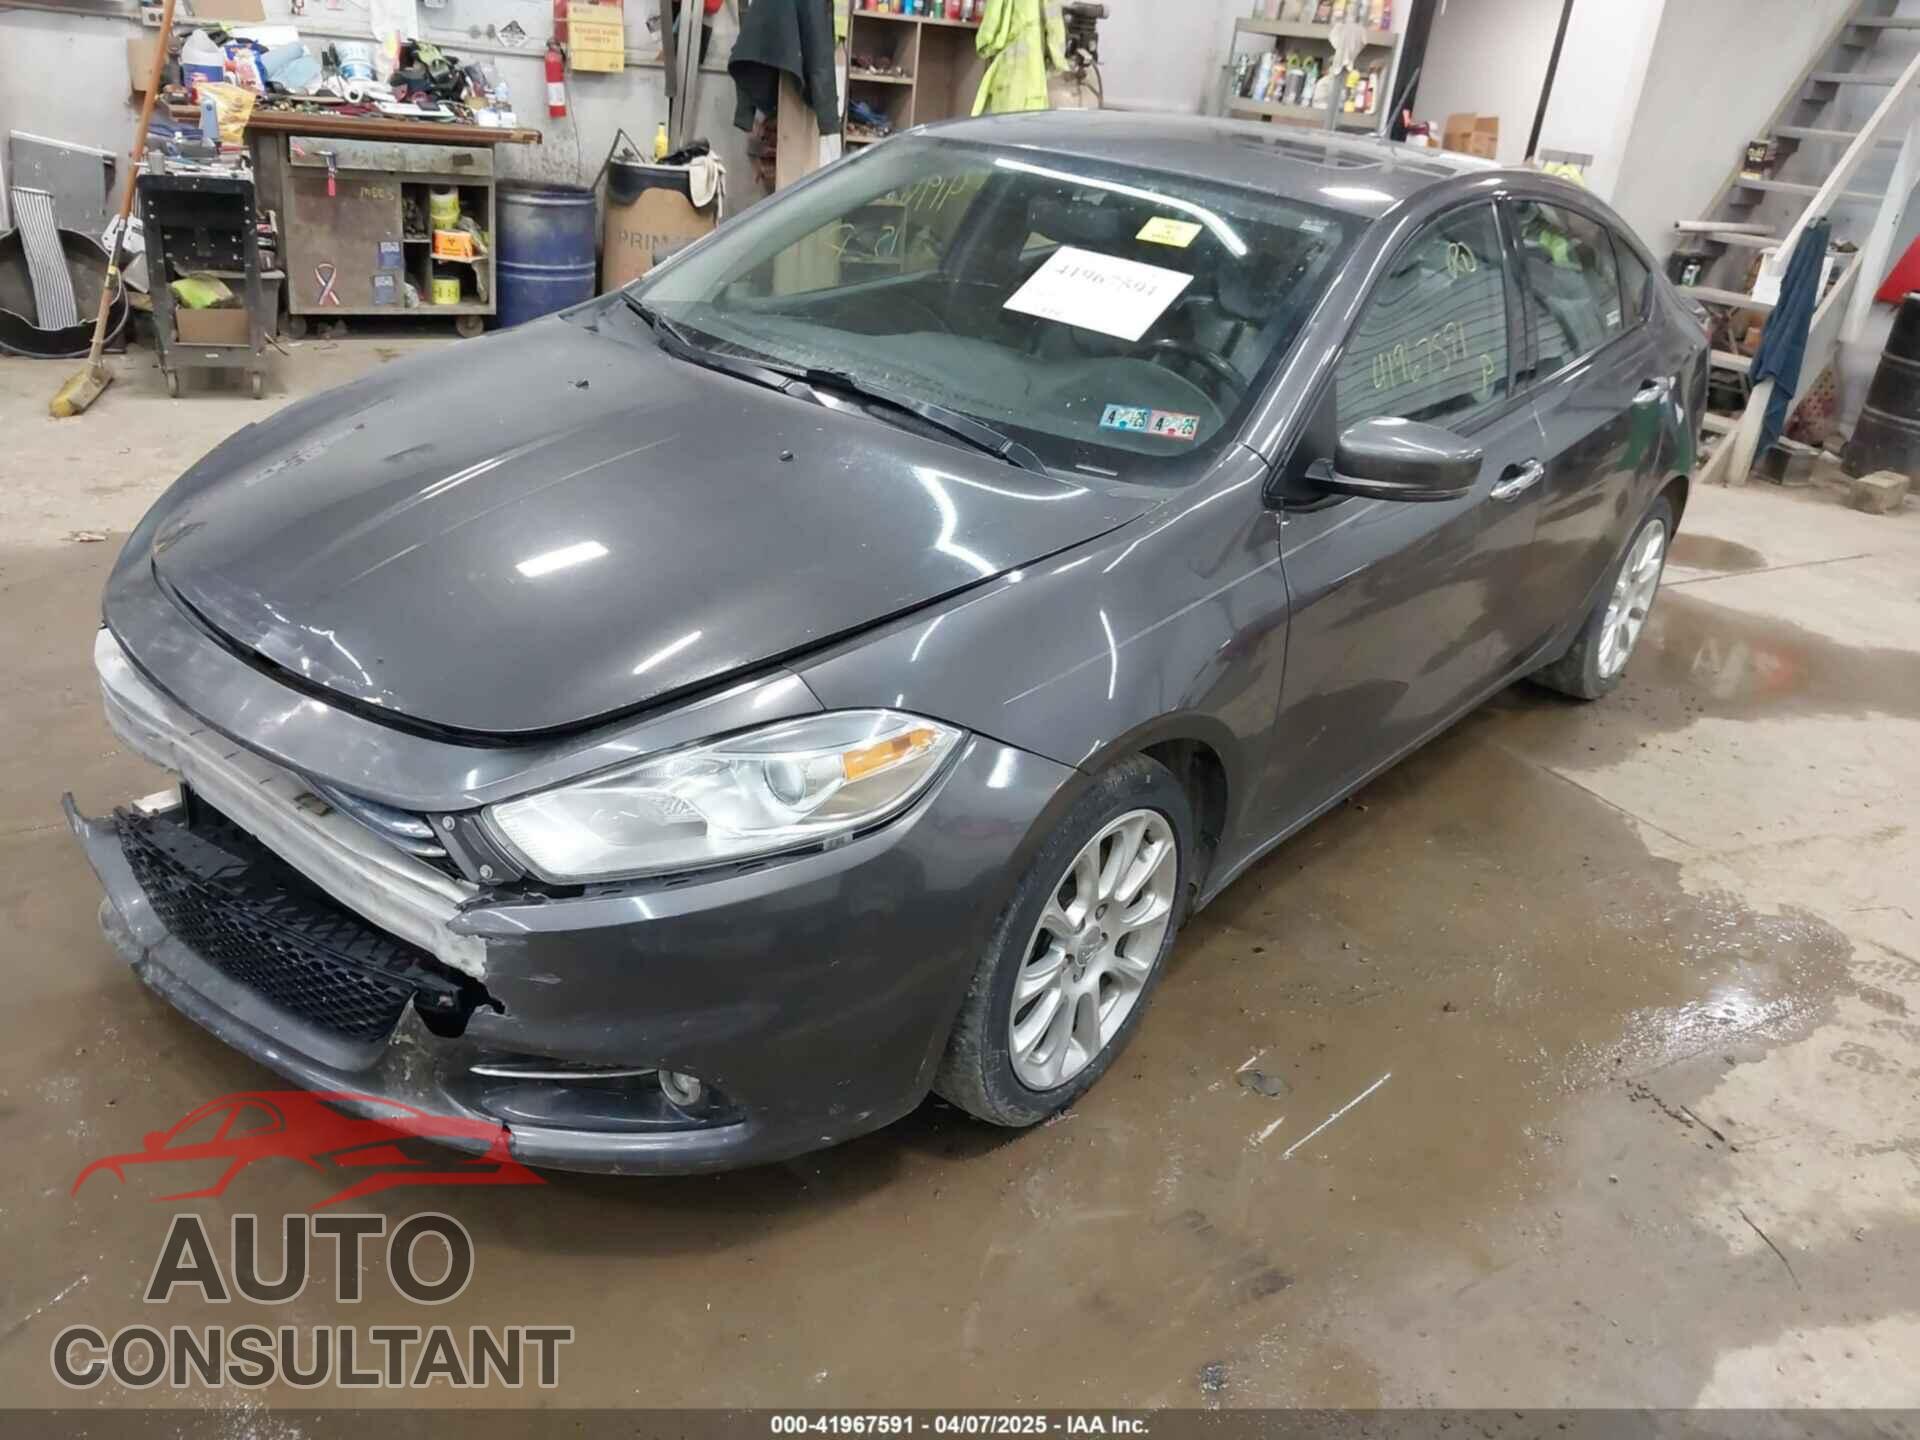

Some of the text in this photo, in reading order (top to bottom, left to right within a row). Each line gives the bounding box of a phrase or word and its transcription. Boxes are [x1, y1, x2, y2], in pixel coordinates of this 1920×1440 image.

[1479, 354, 1495, 394] P
[1107, 410, 1117, 424] 4
[1155, 417, 1164, 431] 4
